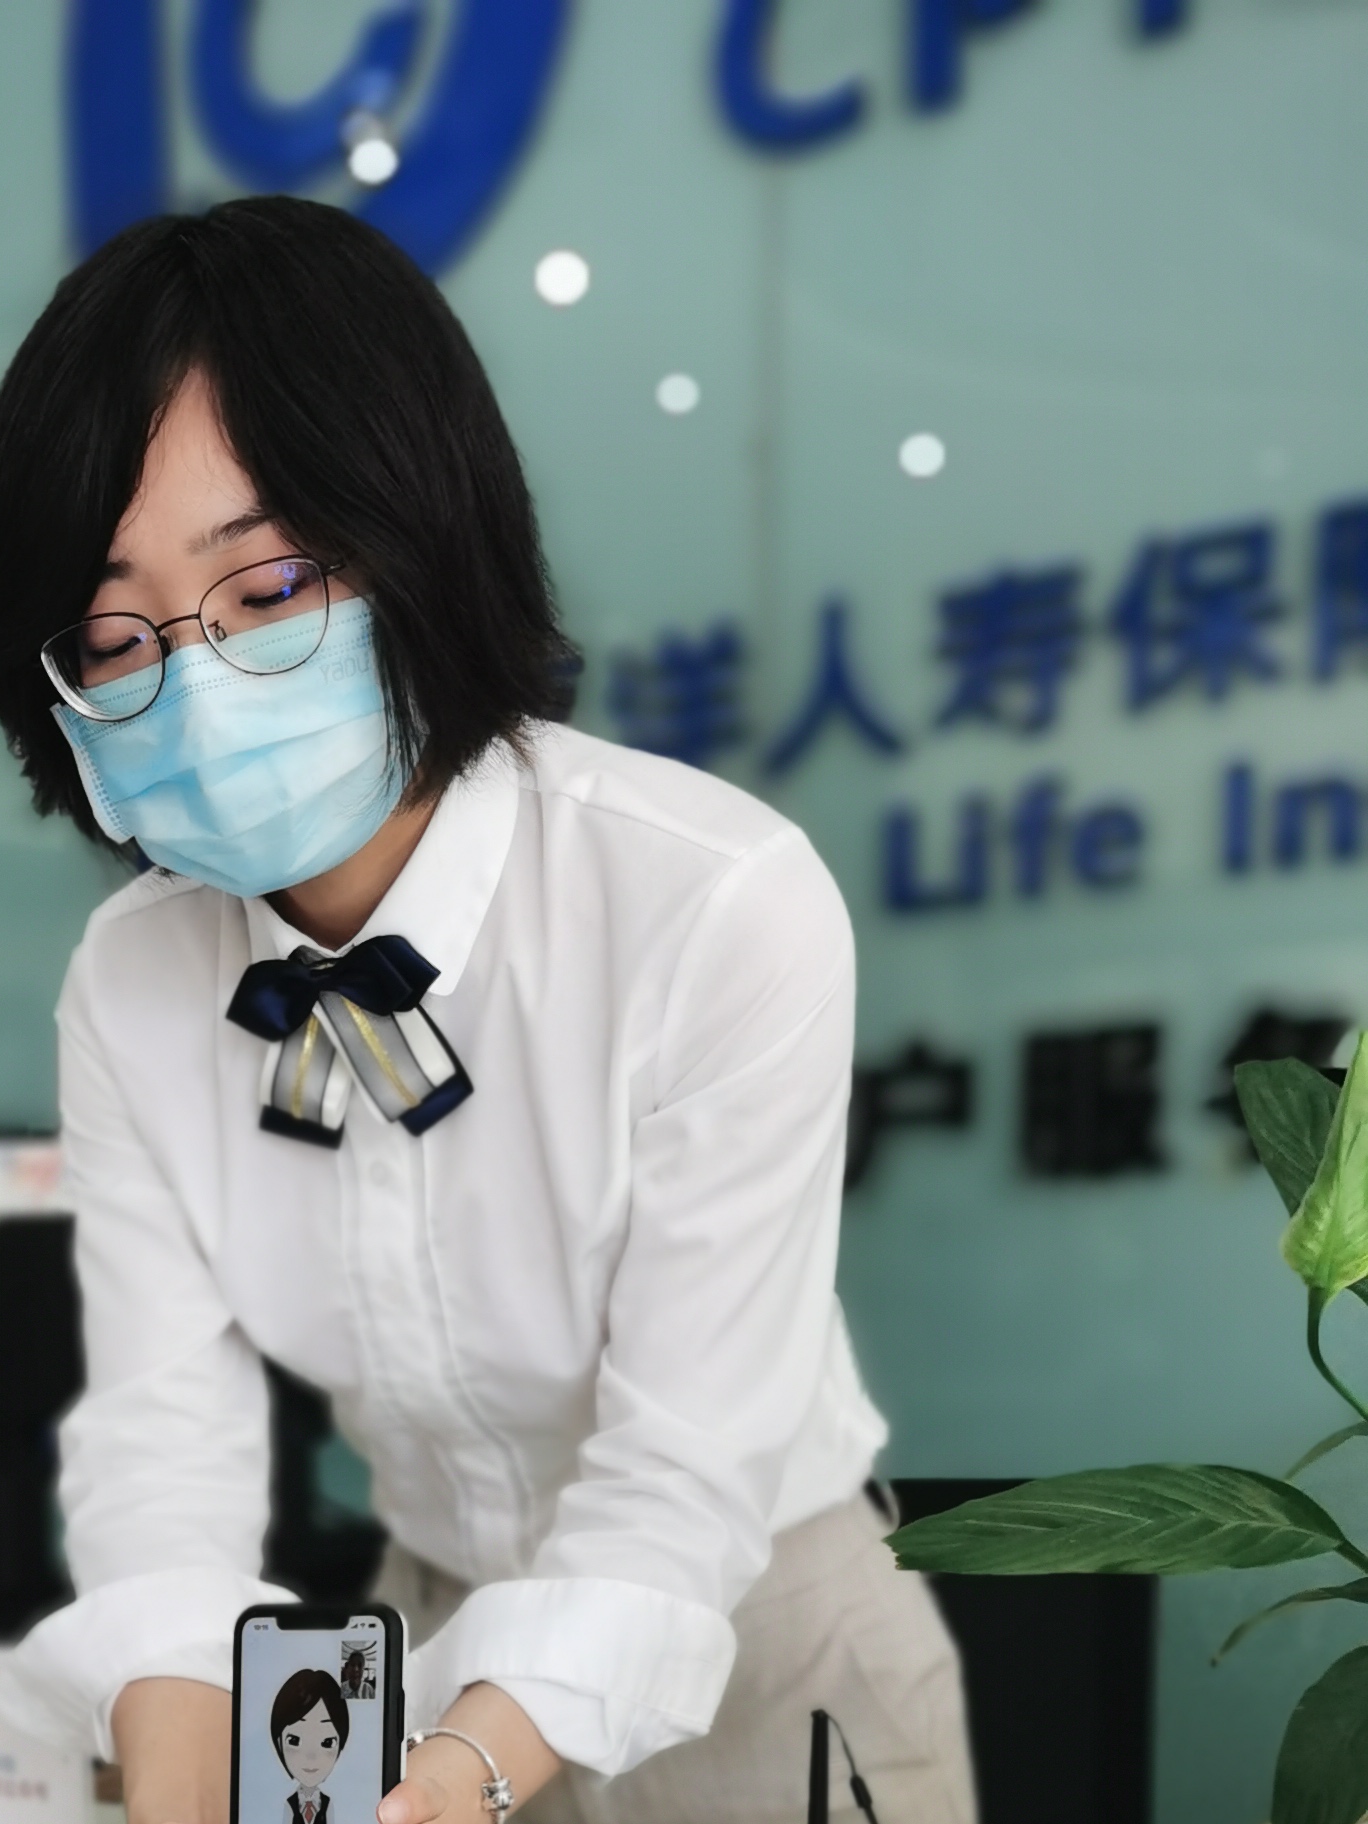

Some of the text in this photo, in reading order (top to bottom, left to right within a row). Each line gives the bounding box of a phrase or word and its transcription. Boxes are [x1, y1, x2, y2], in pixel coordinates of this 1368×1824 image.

[557, 497, 1368, 782] 洋人寿保
[882, 775, 1146, 916] Life
